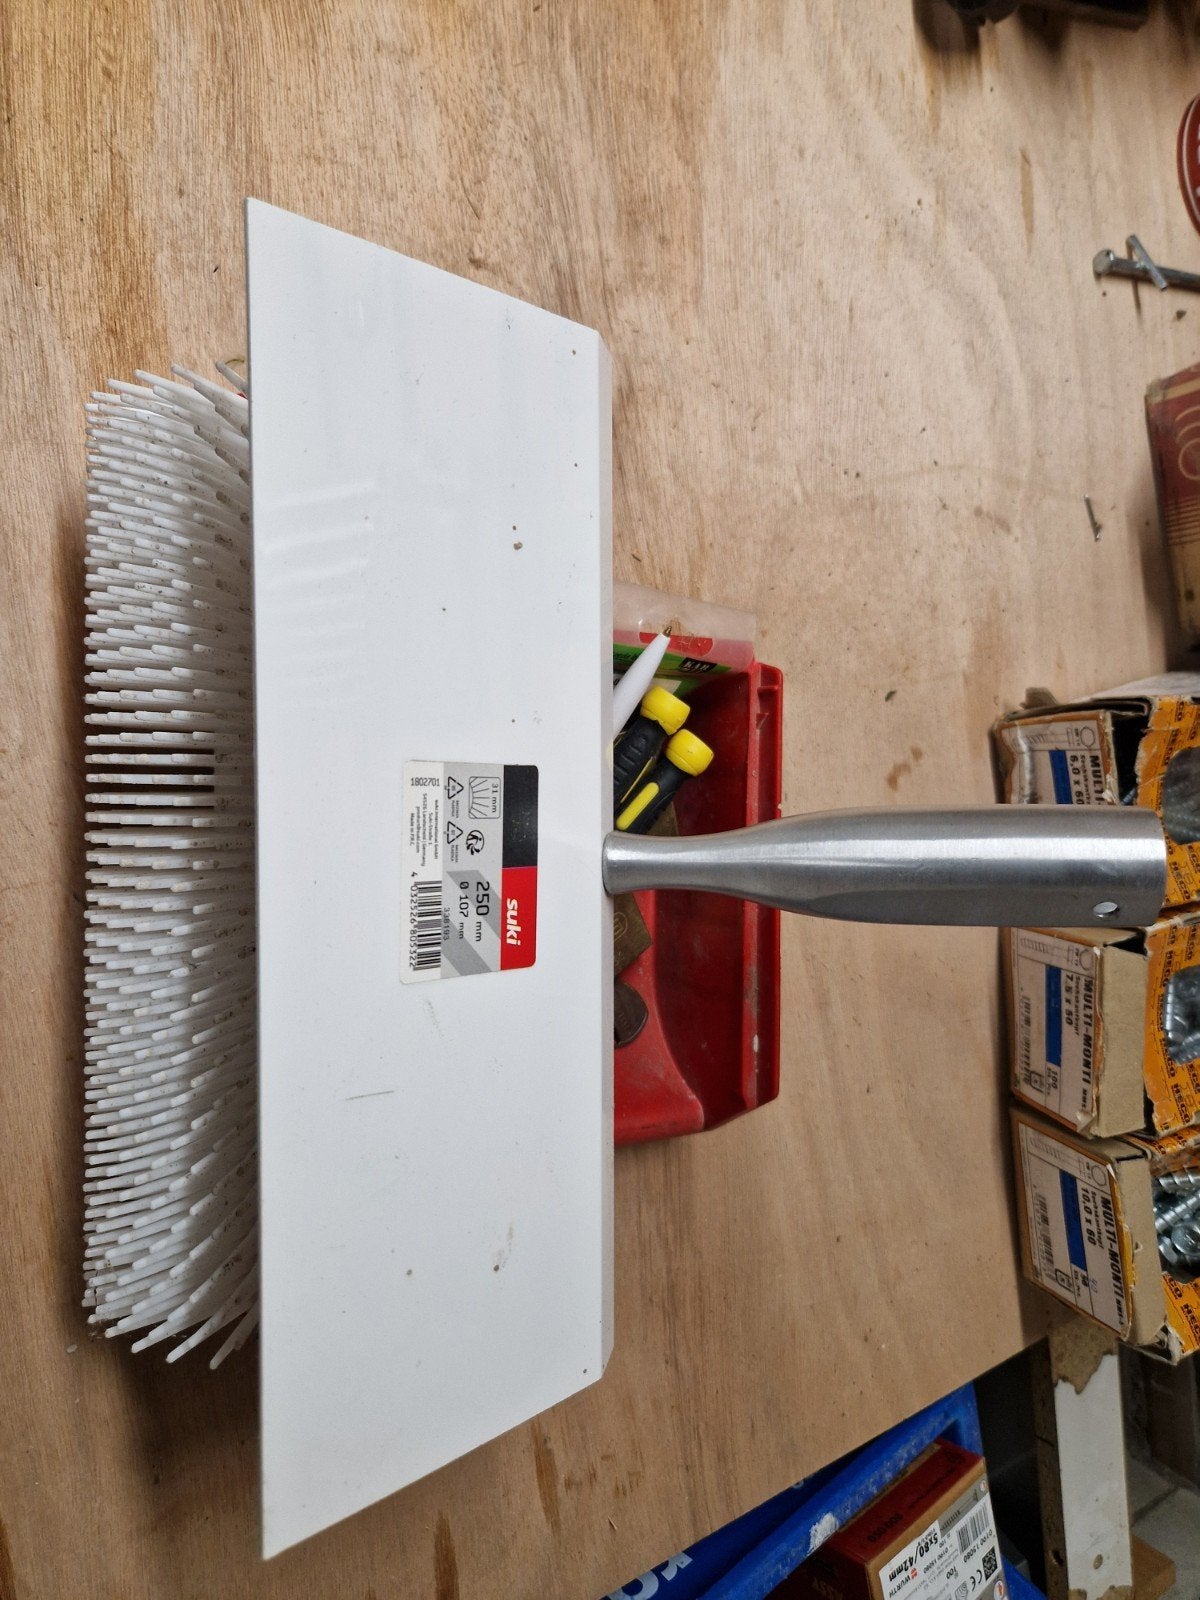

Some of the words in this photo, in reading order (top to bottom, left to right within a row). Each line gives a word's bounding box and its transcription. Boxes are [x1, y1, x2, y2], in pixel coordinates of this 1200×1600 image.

[410, 777, 440, 787] 1802701
[491, 783, 499, 794] 31
[491, 796, 497, 813] mm
[410, 885, 418, 924] 032526
[459, 894, 469, 918] 107
[475, 881, 490, 916] 250
[458, 922, 464, 940] mm
[475, 921, 481, 941] mm
[506, 898, 521, 946] suki
[409, 929, 418, 968] 805322
[1083, 977, 1093, 1085] MULTI-MONTI
[1101, 1196, 1125, 1299] MULTI-MONTI
